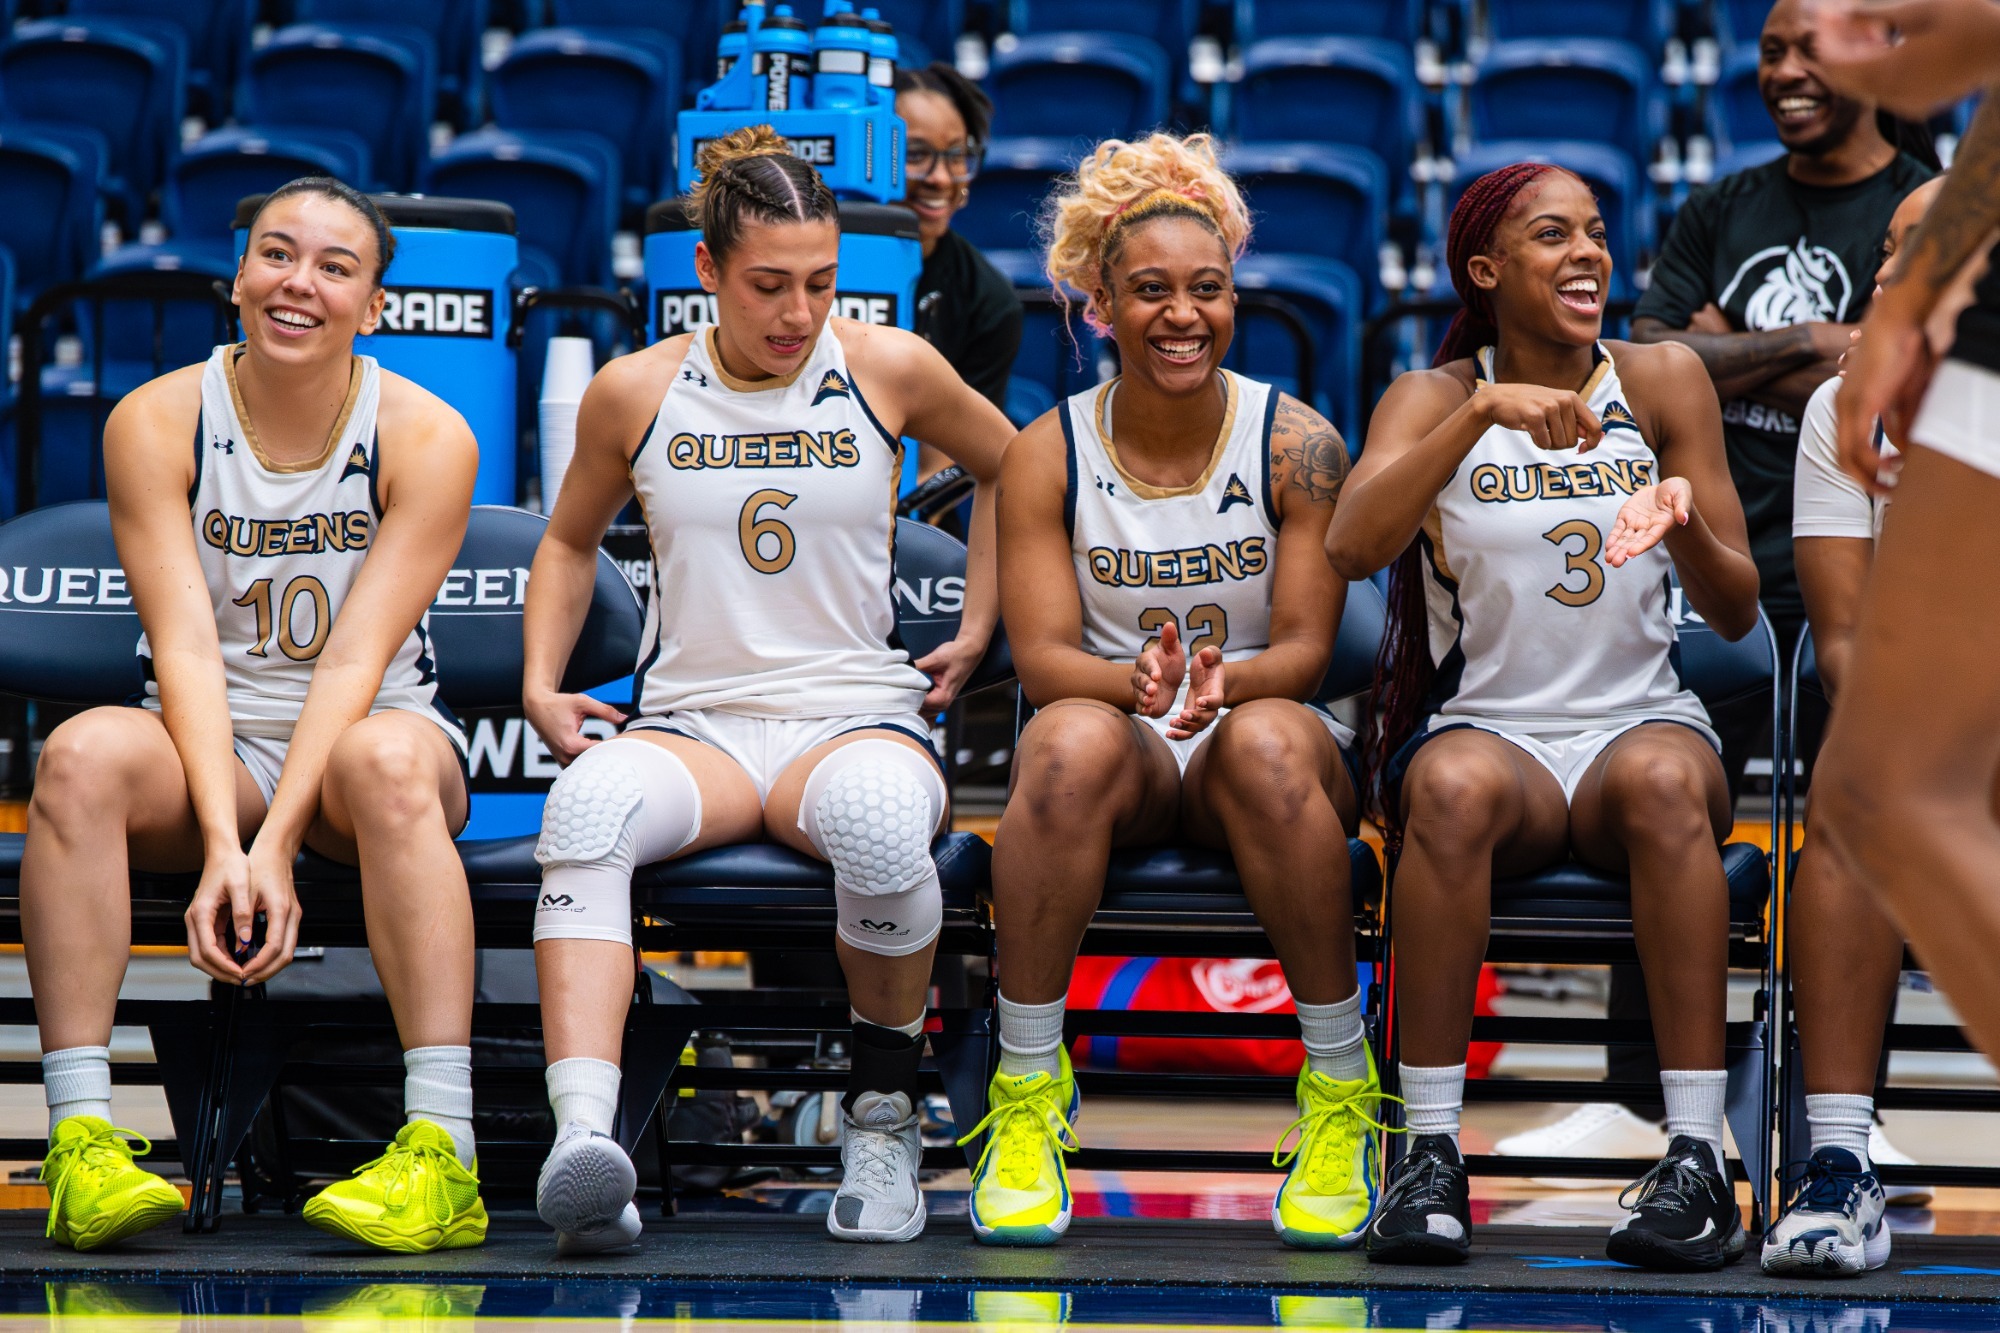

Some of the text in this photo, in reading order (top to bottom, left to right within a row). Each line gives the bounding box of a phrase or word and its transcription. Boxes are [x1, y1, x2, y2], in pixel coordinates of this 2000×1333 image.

[375, 292, 486, 333] RADE
[667, 428, 860, 470] QUEENS
[1470, 459, 1653, 503] QUEENS
[203, 509, 368, 557] QUEENS
[738, 489, 798, 574] 6
[1088, 537, 1268, 588] QUEENS
[1542, 519, 1605, 607] 3
[232, 575, 331, 661] 10
